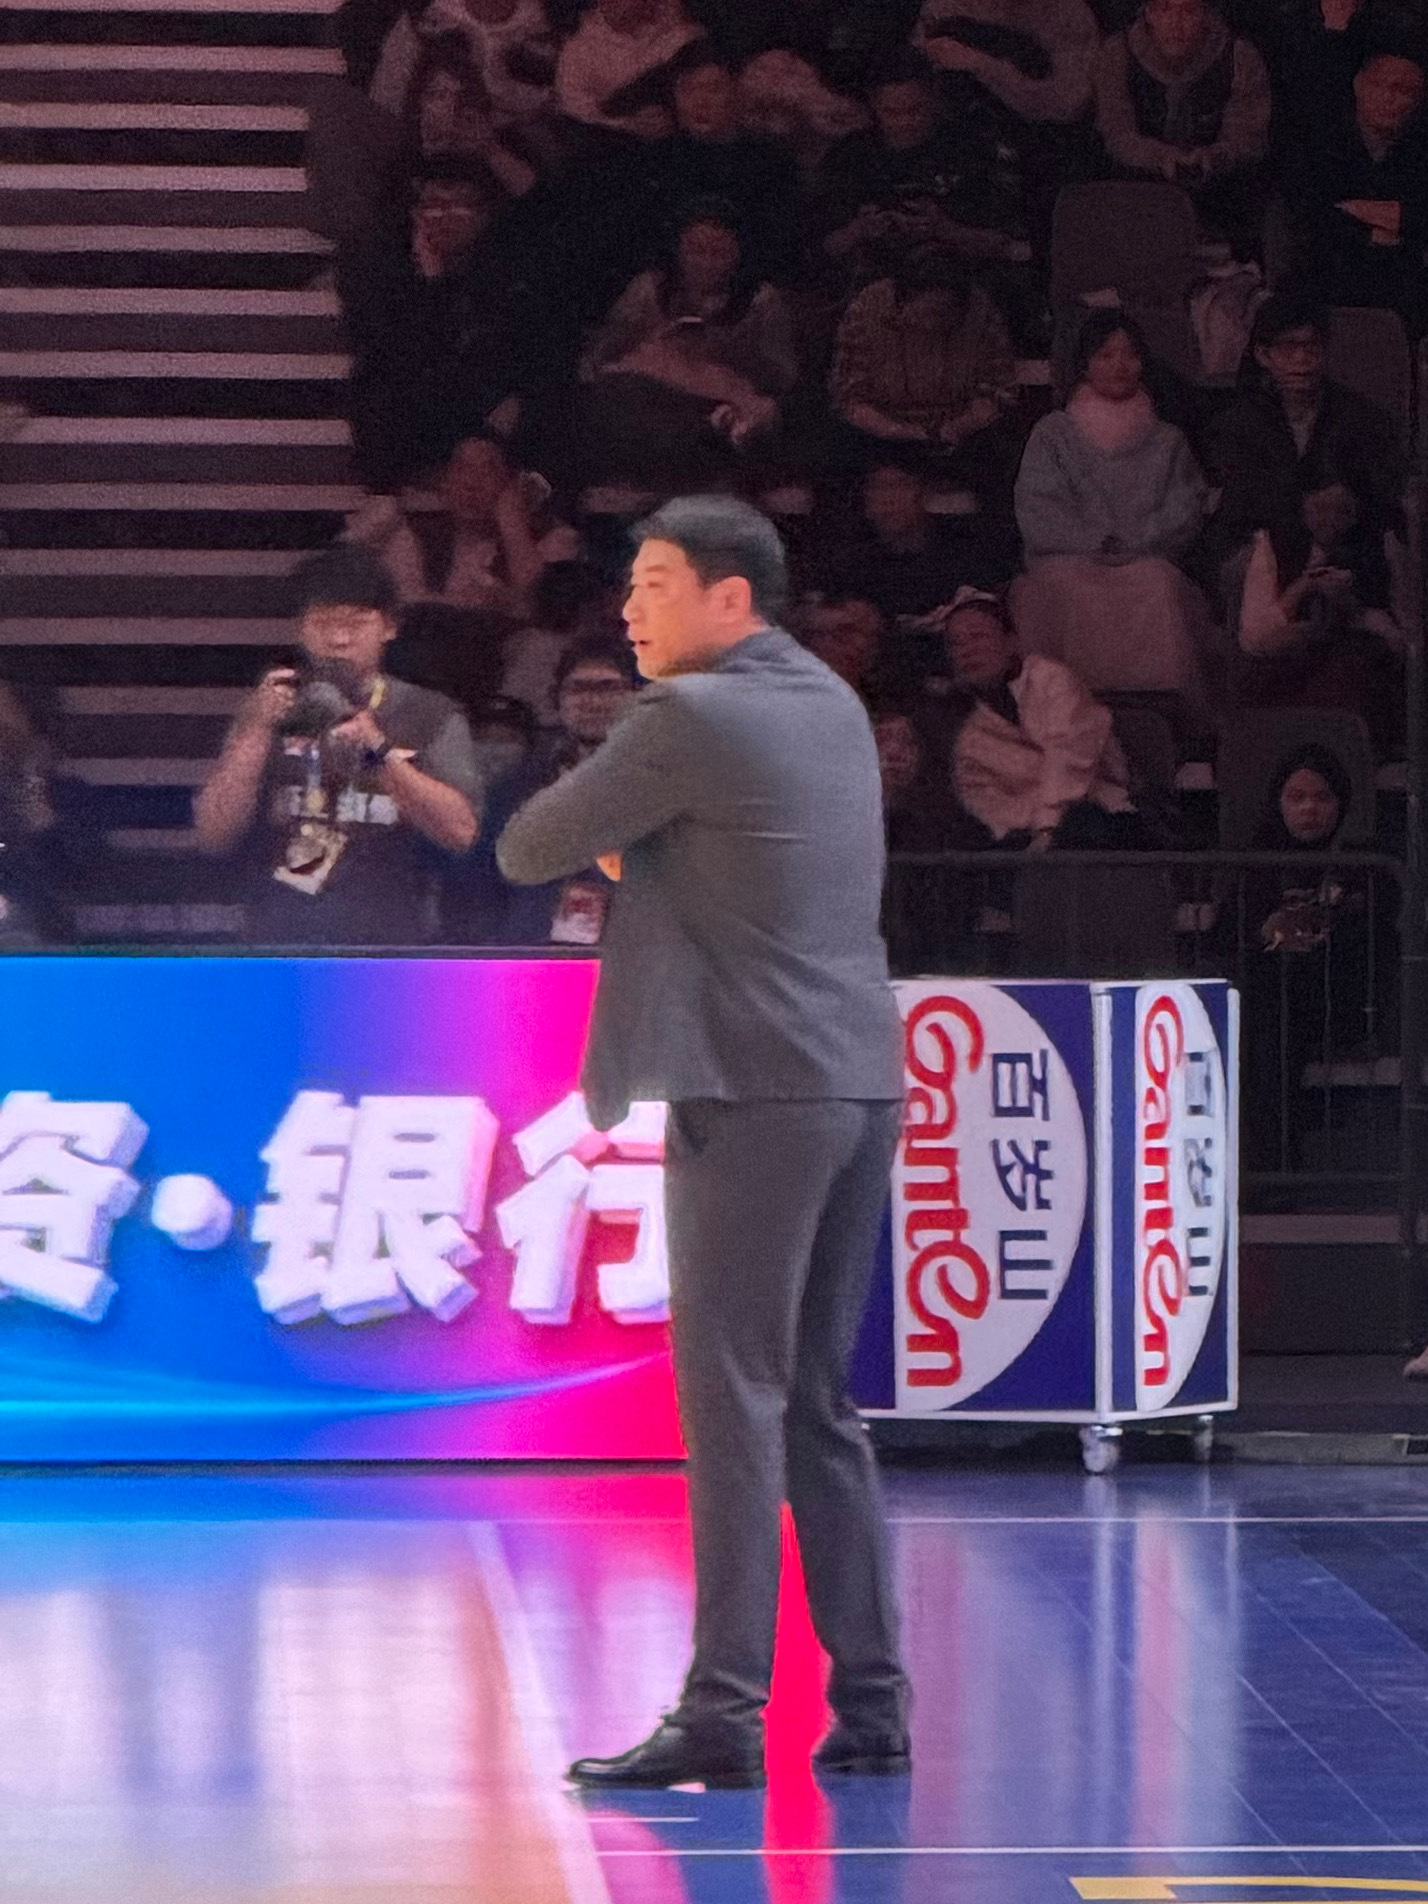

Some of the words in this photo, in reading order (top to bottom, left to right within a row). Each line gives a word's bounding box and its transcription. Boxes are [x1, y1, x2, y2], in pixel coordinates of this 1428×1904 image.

[904, 995, 991, 1387] Ganten
[991, 1049, 1055, 1300] 百岁山
[1143, 995, 1186, 1386] Ganten
